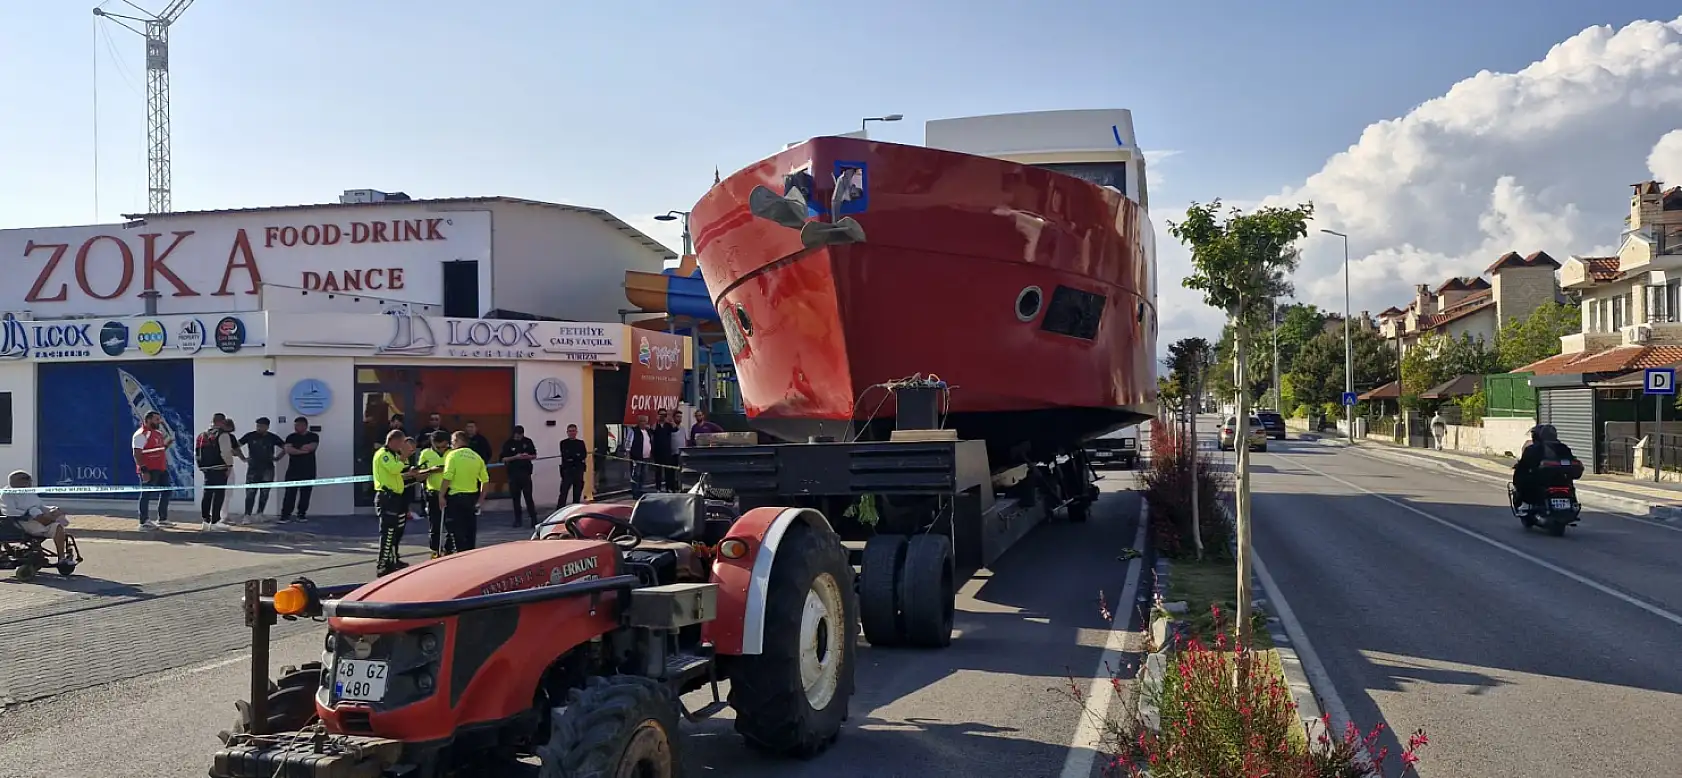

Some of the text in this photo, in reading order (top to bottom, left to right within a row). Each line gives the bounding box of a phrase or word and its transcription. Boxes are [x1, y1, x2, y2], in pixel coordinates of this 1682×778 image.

[264, 218, 446, 247] FOOD-DRINK
[23, 228, 262, 303] ZOKA
[302, 268, 405, 292] DANCE
[559, 325, 605, 337] FETHİYE
[1654, 374, 1665, 388] D
[631, 394, 651, 415] ÇOK
[562, 556, 598, 578] ERKUNT
[339, 662, 386, 679] 48 GZ
[345, 681, 370, 697] 480
